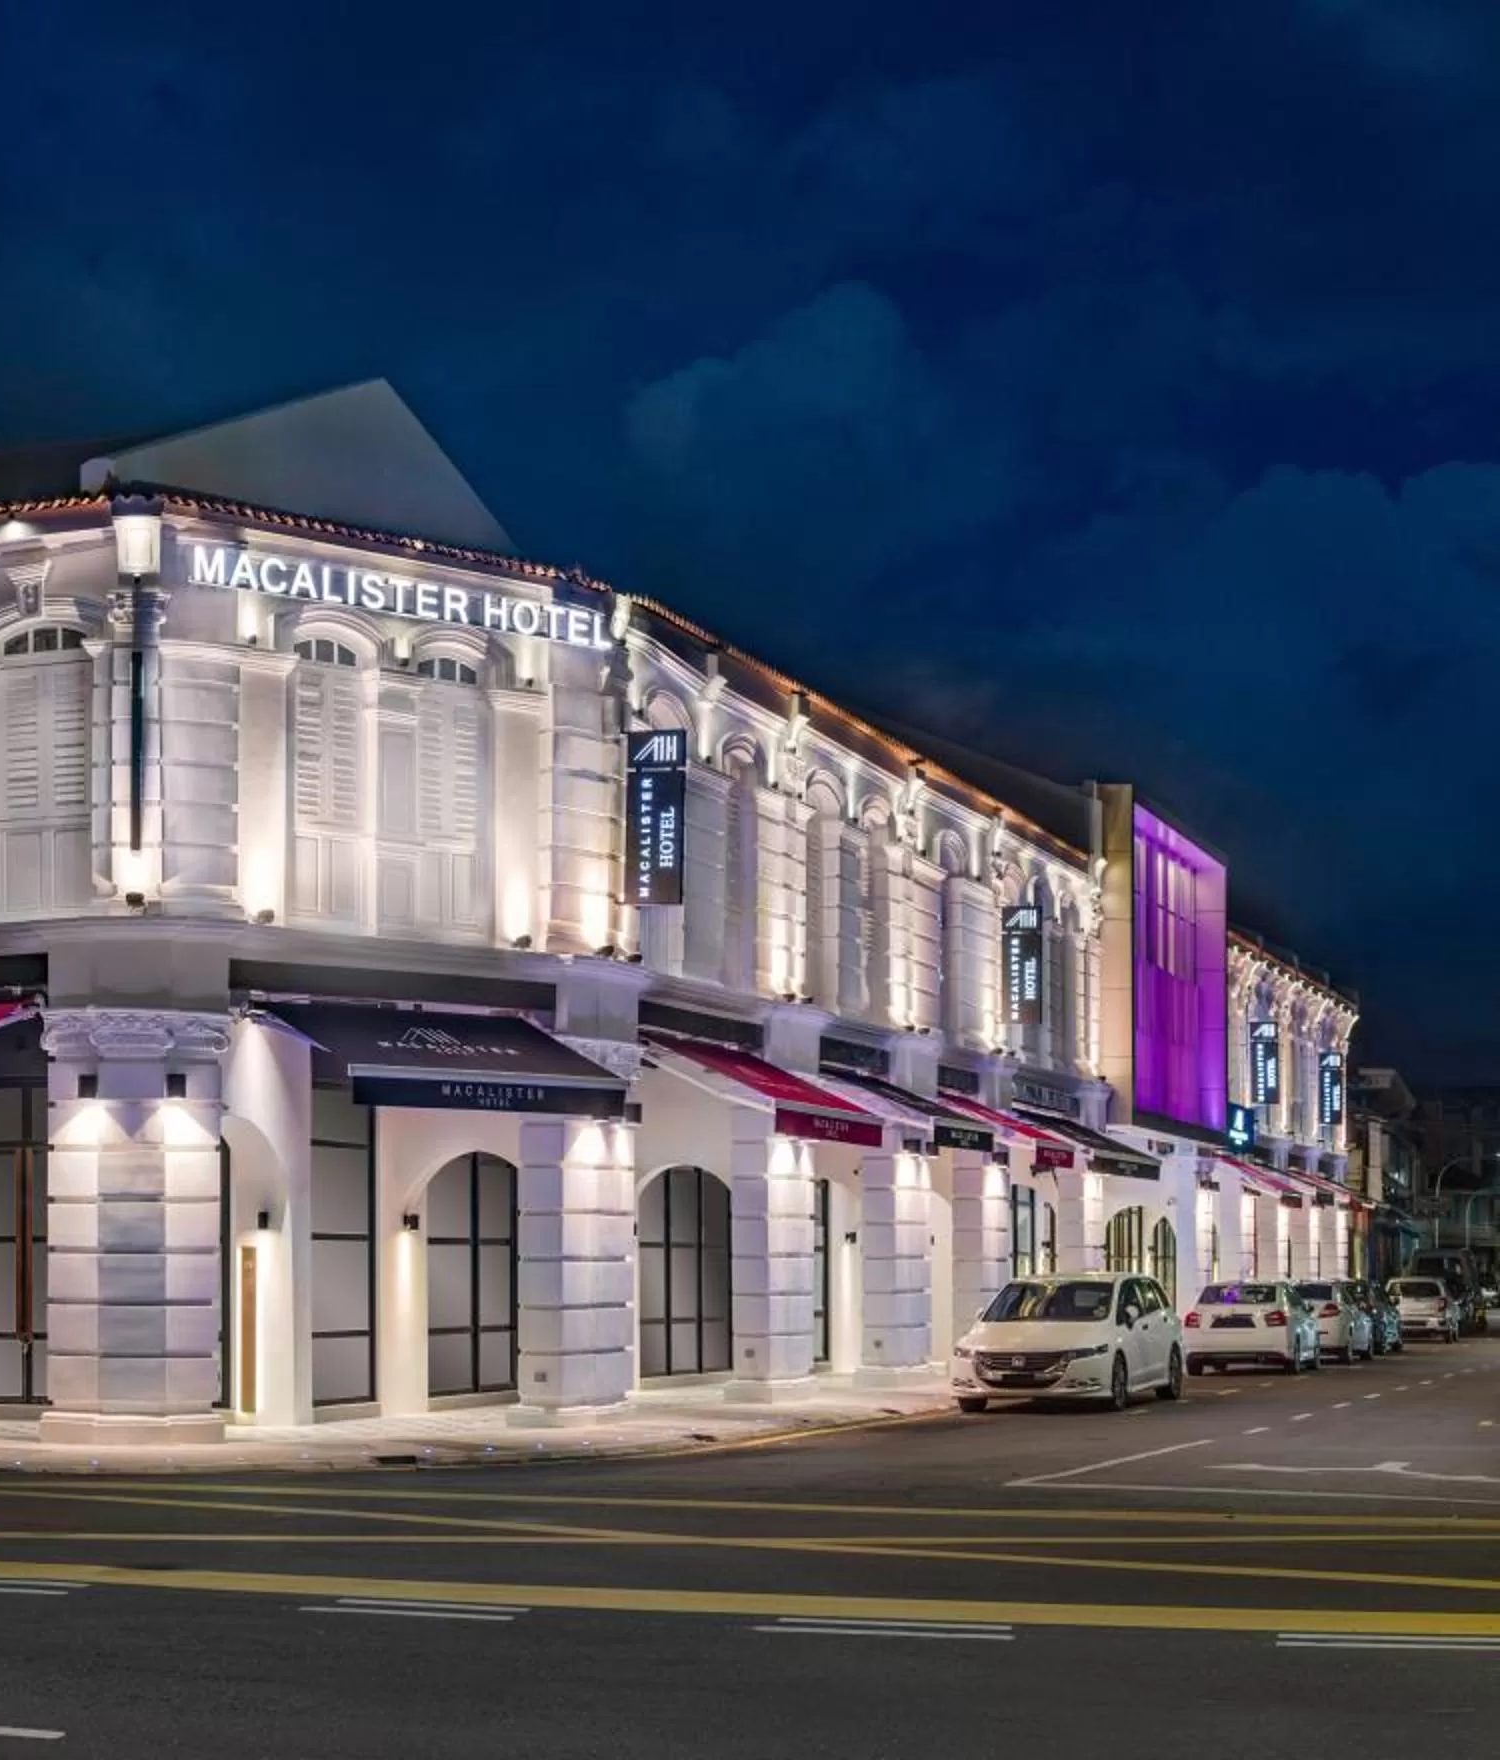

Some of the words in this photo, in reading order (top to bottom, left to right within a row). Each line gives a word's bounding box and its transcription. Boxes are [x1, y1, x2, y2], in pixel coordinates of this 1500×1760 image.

[191, 544, 470, 624] MACALISTER
[483, 593, 613, 649] HOTEL
[639, 777, 653, 898] MACALISTER
[659, 804, 675, 869] HOTEL
[442, 1084, 544, 1100] MACALISTER
